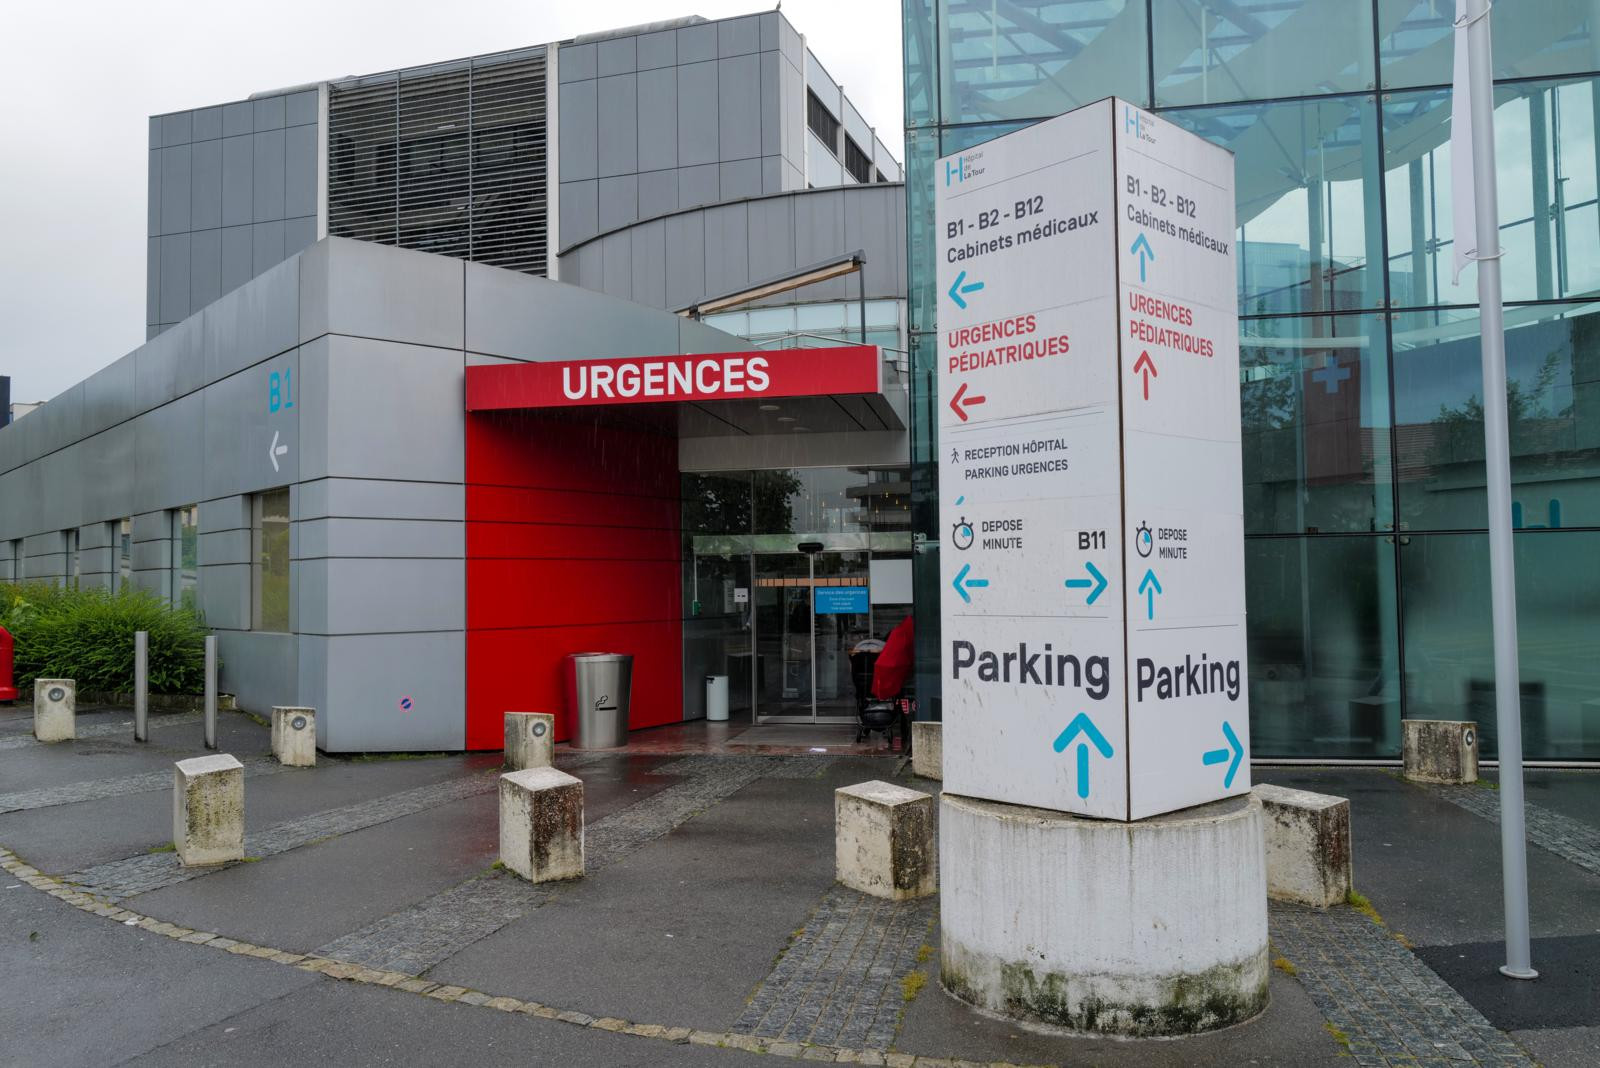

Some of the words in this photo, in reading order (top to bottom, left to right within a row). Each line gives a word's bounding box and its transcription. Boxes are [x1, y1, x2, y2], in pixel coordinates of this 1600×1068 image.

[972, 167, 985, 177] Tour
[1127, 174, 1140, 197] B1
[1151, 185, 1166, 208] B2
[1177, 195, 1196, 219] B12
[947, 219, 964, 239] B1
[978, 208, 1000, 230] B2
[1015, 195, 1044, 220] B12
[1127, 203, 1176, 237] Cabinets
[1178, 226, 1229, 256] médicaux
[947, 235, 1013, 263] Cabinets
[1017, 210, 1099, 246] médicaux
[1129, 292, 1193, 327] URGENCES
[948, 315, 1037, 349] URGENCES
[1130, 319, 1214, 358] PÉDIATRIQUES
[949, 335, 1070, 374] PÉDIATRIQUES
[270, 367, 294, 414] B1
[562, 357, 770, 400] URGENCES
[964, 445, 1020, 461] RECEPTION
[1022, 438, 1068, 455] HÔPITAL
[965, 465, 1009, 480] PARKING
[1011, 459, 1069, 476] URGENCES
[981, 519, 1023, 533] DEPOSE
[982, 537, 1023, 550] MINUTE
[1078, 530, 1106, 550] B11
[1158, 528, 1188, 541] DEPOSE
[1159, 546, 1188, 560] MINUTE
[951, 640, 1111, 701] Parking
[1137, 652, 1240, 702] Parking
